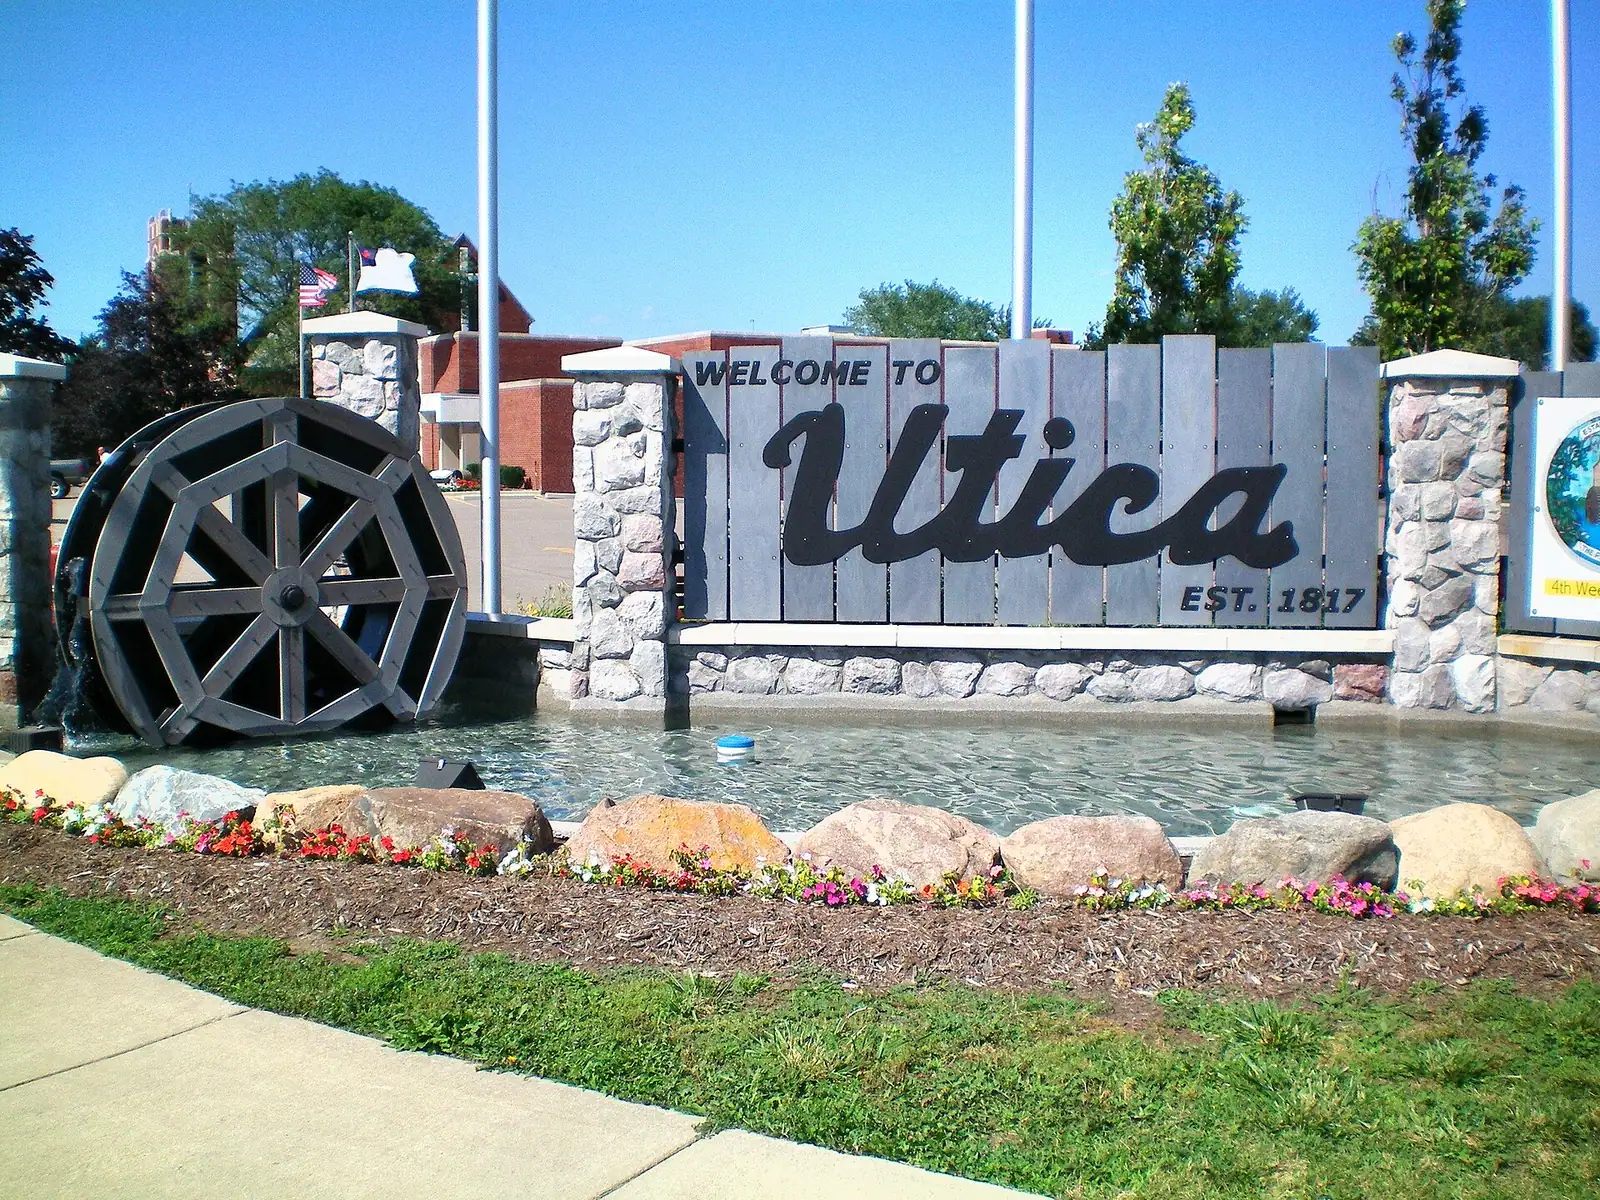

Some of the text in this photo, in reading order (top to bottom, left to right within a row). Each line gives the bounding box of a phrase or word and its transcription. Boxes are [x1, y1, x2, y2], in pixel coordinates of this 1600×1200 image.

[695, 359, 941, 386] WELCOME TO
[763, 403, 1299, 568] Utica
[1181, 586, 1365, 613] EST. 1817
[1551, 580, 1571, 594] 4th
